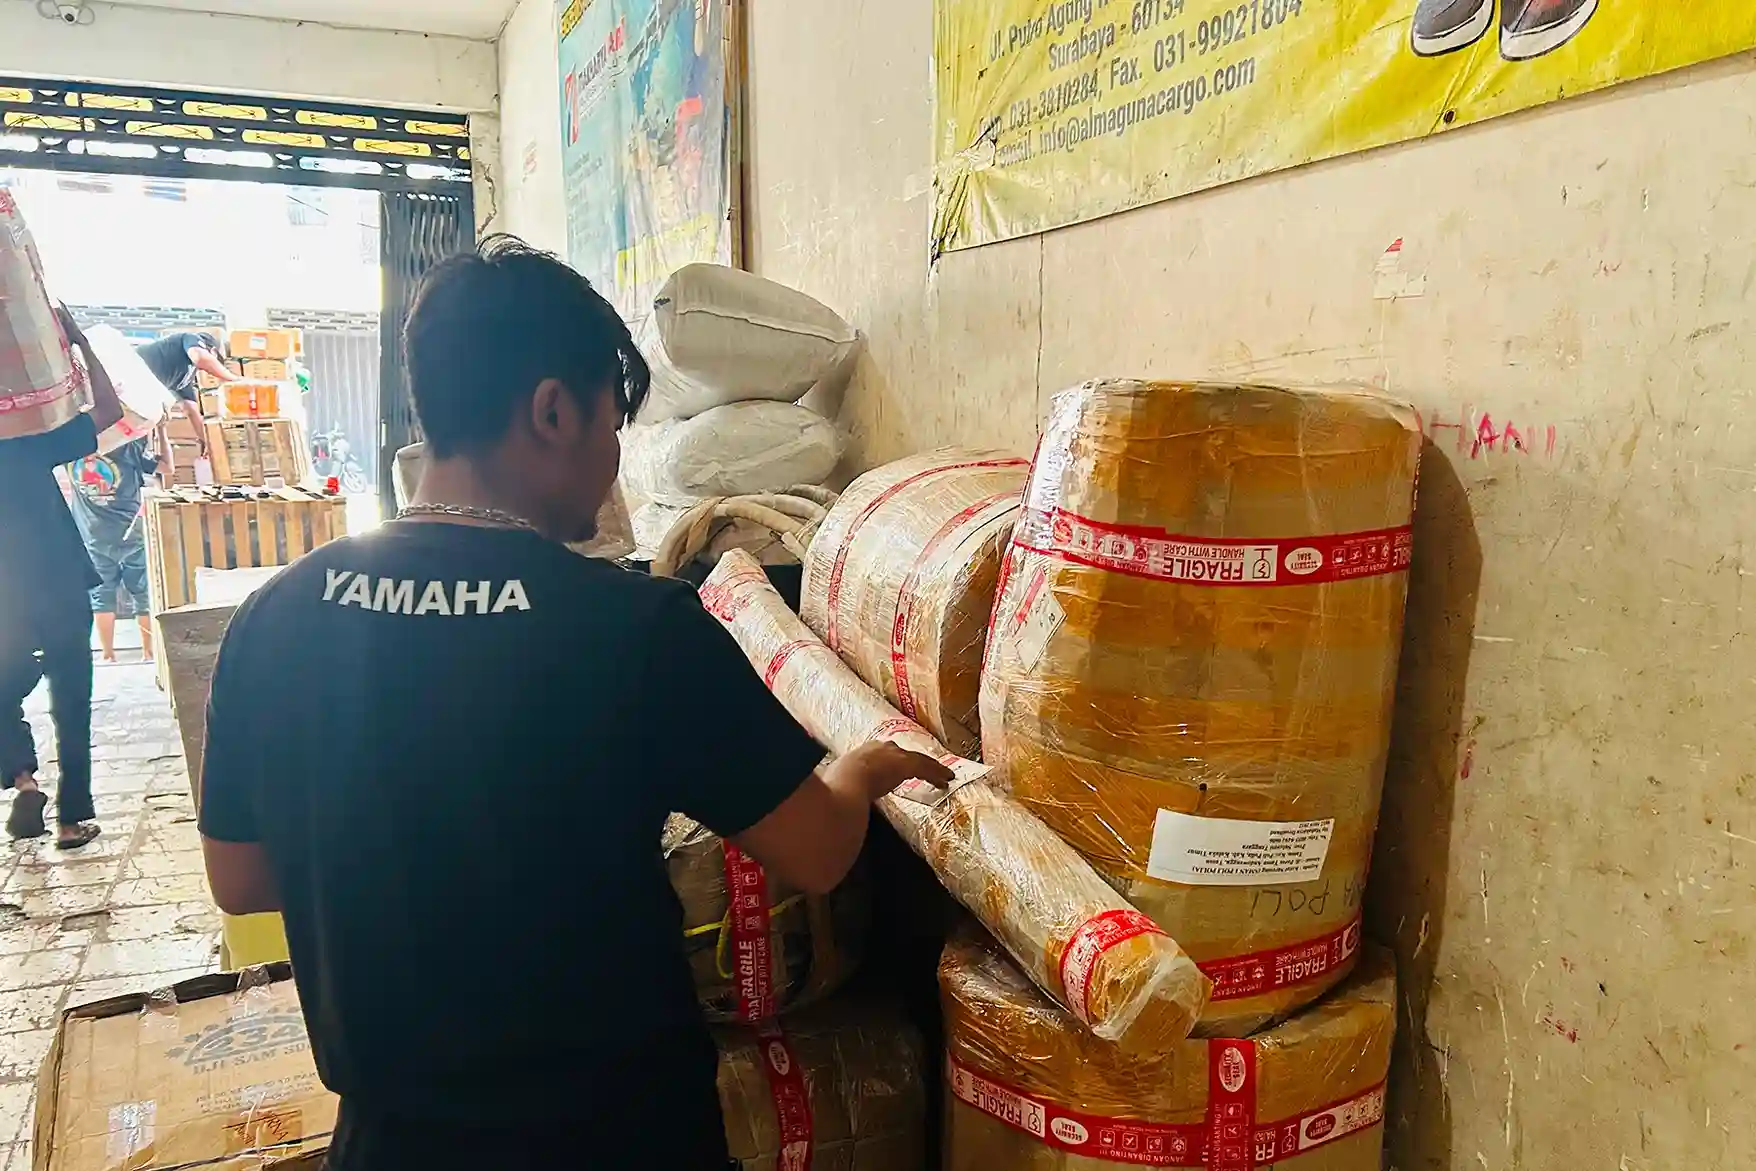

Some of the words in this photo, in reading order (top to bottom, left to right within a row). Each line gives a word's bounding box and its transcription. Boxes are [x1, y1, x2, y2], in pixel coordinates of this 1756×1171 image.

[1049, 20, 1115, 72] Surabaya
[1109, 56, 1143, 90] Fax.
[1039, 56, 1256, 154] info@almagunacargo.com
[1163, 543, 1187, 556] CARE
[1188, 545, 1210, 559] WITH
[1210, 547, 1244, 560] HANDLE
[1162, 556, 1244, 581] FRAGILE
[322, 568, 531, 615] YAMAHA
[1187, 848, 1207, 857] Timur
[1249, 879, 1331, 918] POLI
[1275, 953, 1327, 984] FRAGILE
[233, 1048, 277, 1067] SAM
[972, 1088, 1022, 1124] FRAGILE
[1109, 1149, 1152, 1162] DIBANTING
